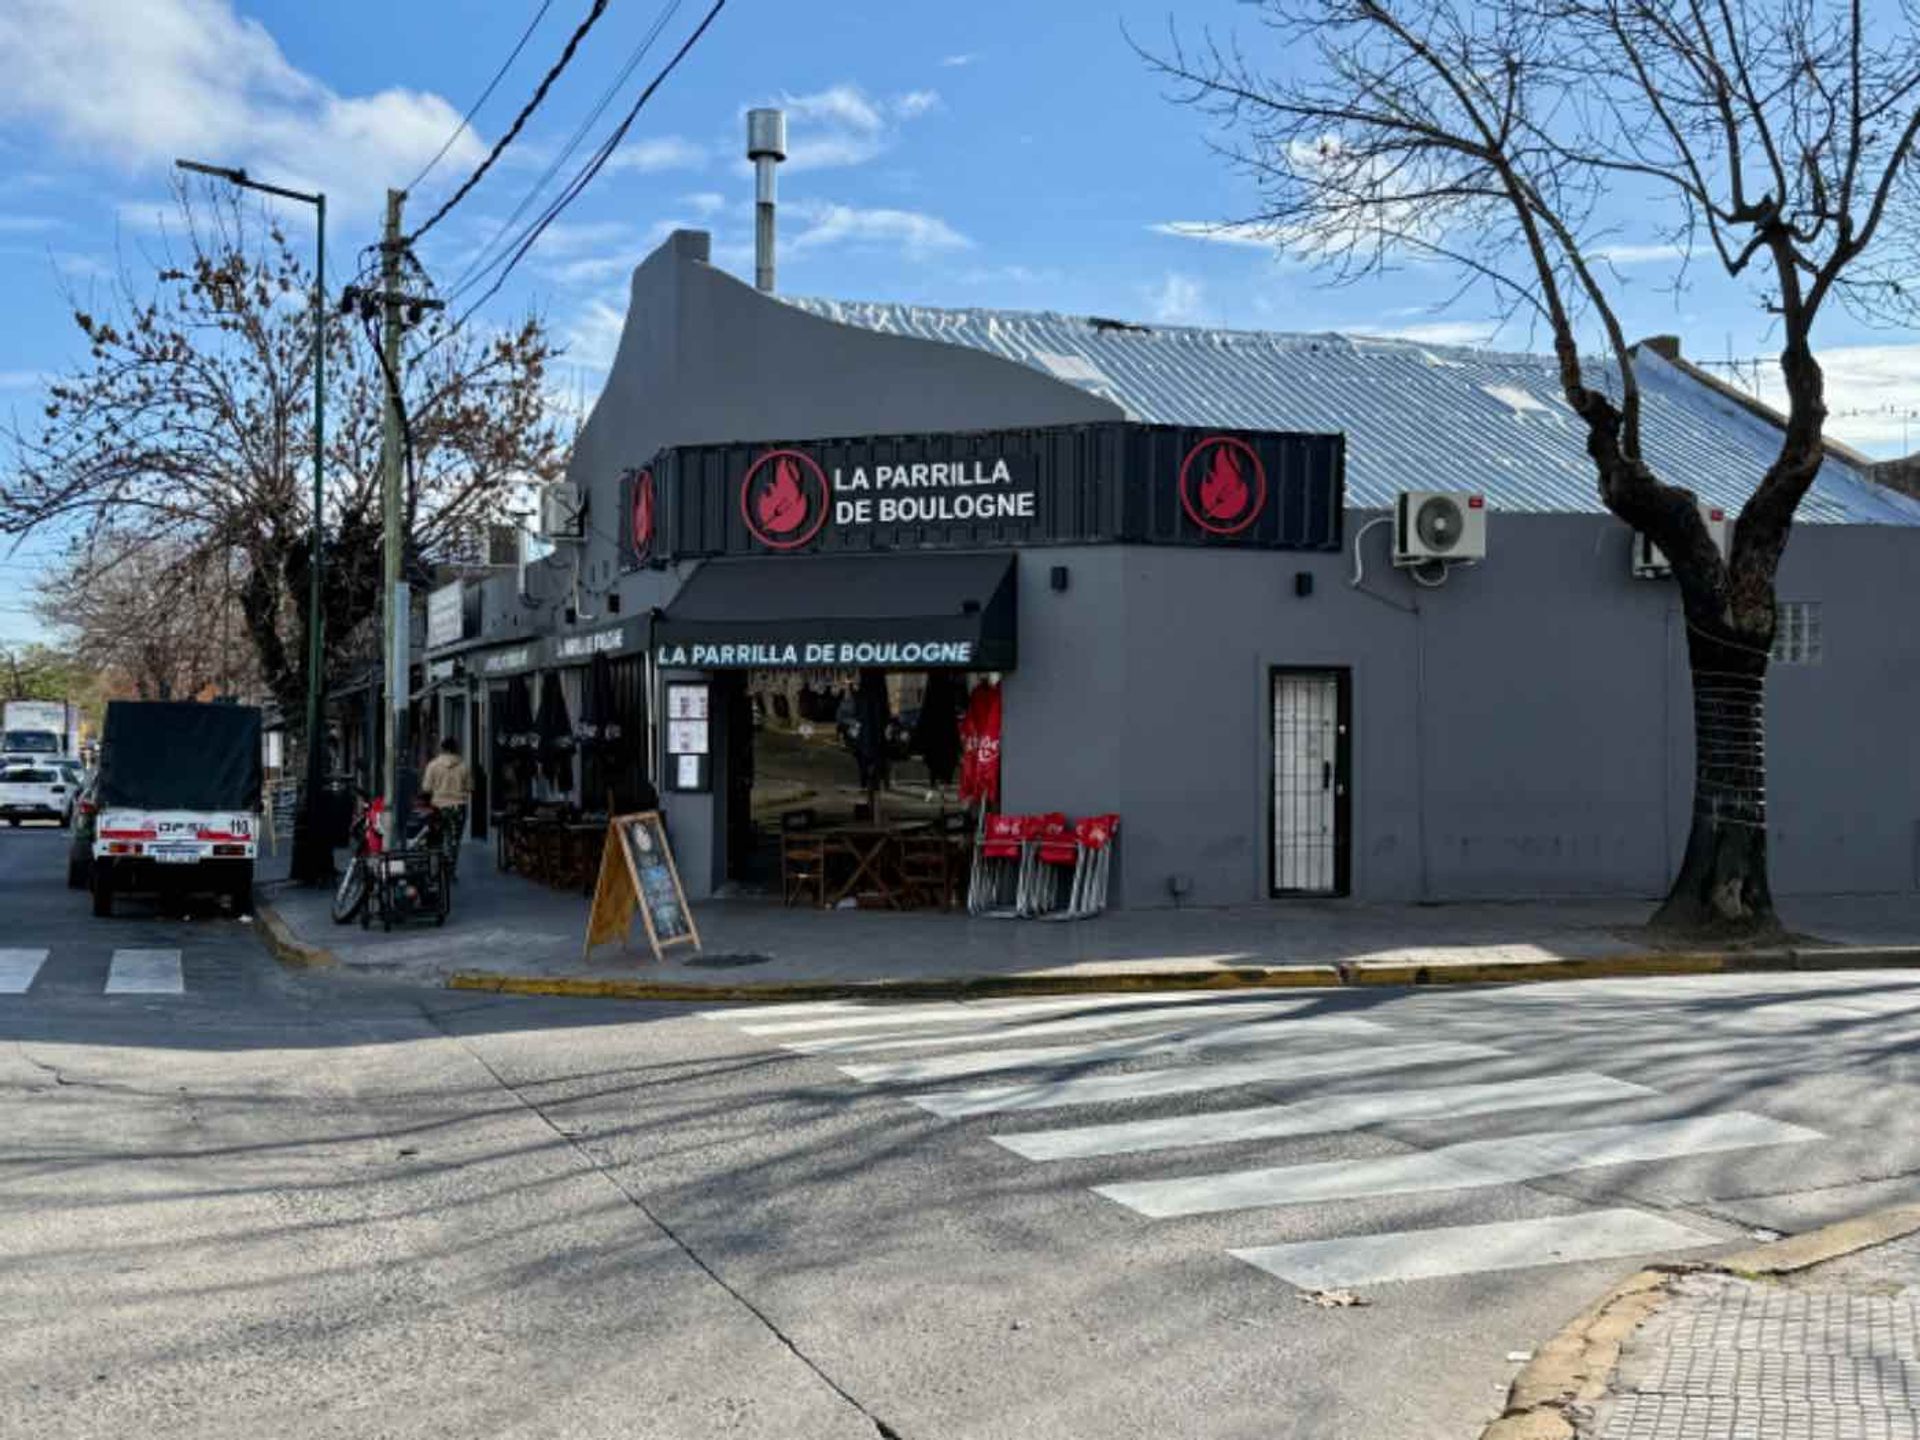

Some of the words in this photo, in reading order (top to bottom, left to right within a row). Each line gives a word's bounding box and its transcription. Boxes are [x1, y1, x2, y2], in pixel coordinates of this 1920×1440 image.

[834, 467, 870, 491] LA
[876, 458, 1010, 490] PARRILLA
[836, 500, 872, 524] DE
[879, 492, 1035, 523] BOULOGNE
[658, 644, 687, 664] LA
[691, 643, 798, 664] PARRILLA
[805, 644, 835, 663] DE
[840, 642, 971, 663] BOULOGNE
